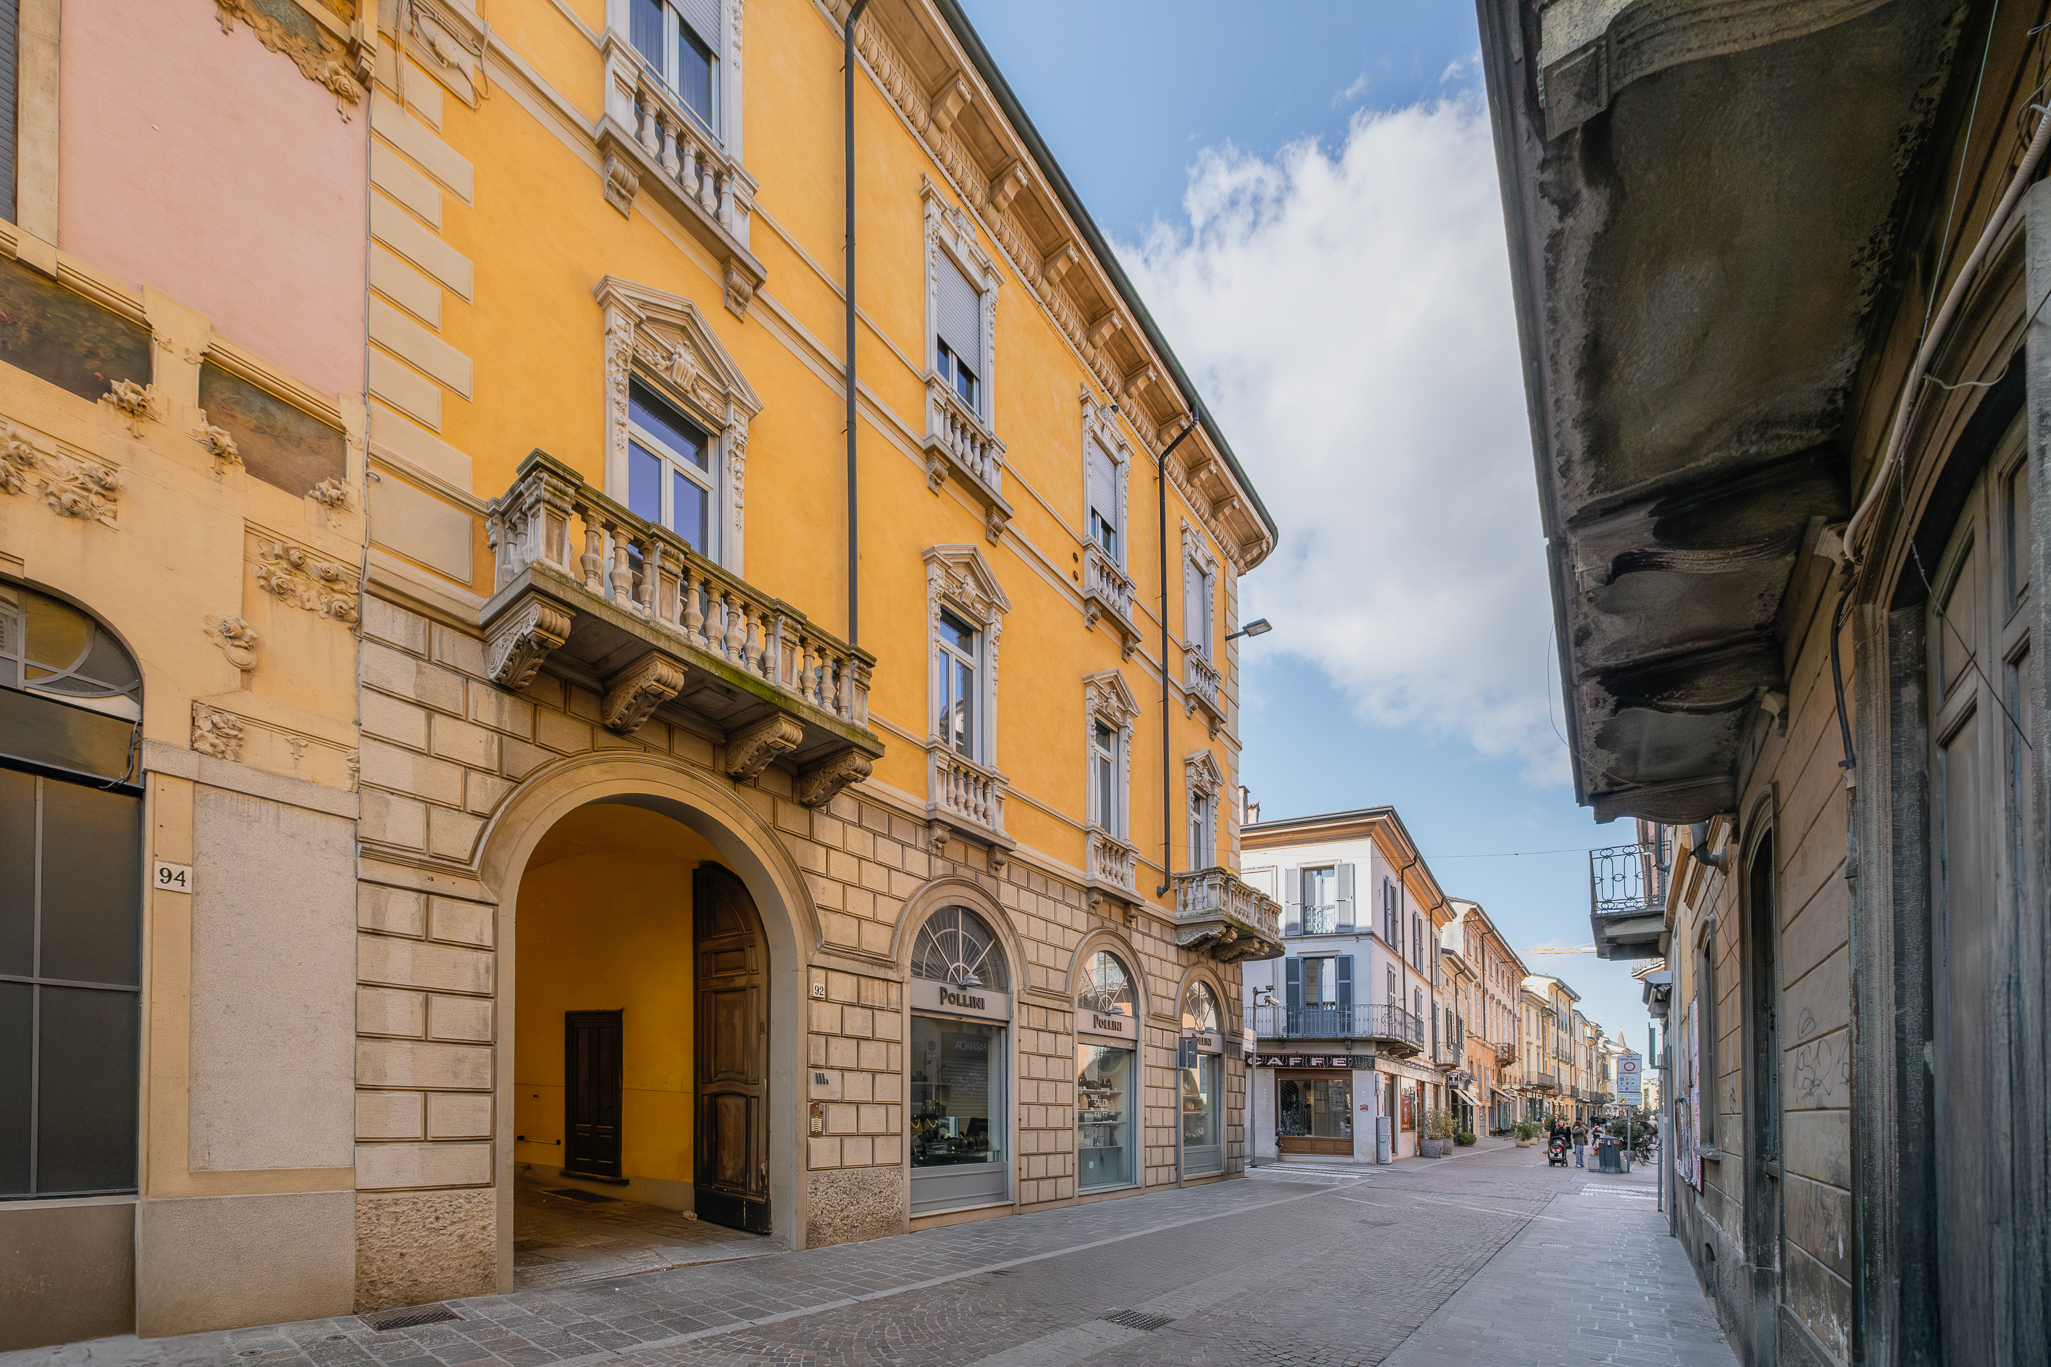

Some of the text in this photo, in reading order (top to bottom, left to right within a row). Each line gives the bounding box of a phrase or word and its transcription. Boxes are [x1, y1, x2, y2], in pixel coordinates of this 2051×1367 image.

[159, 867, 186, 887] 94
[814, 985, 824, 996] 92
[939, 986, 985, 1010] POLLINI
[1093, 1014, 1122, 1031] POLLINI
